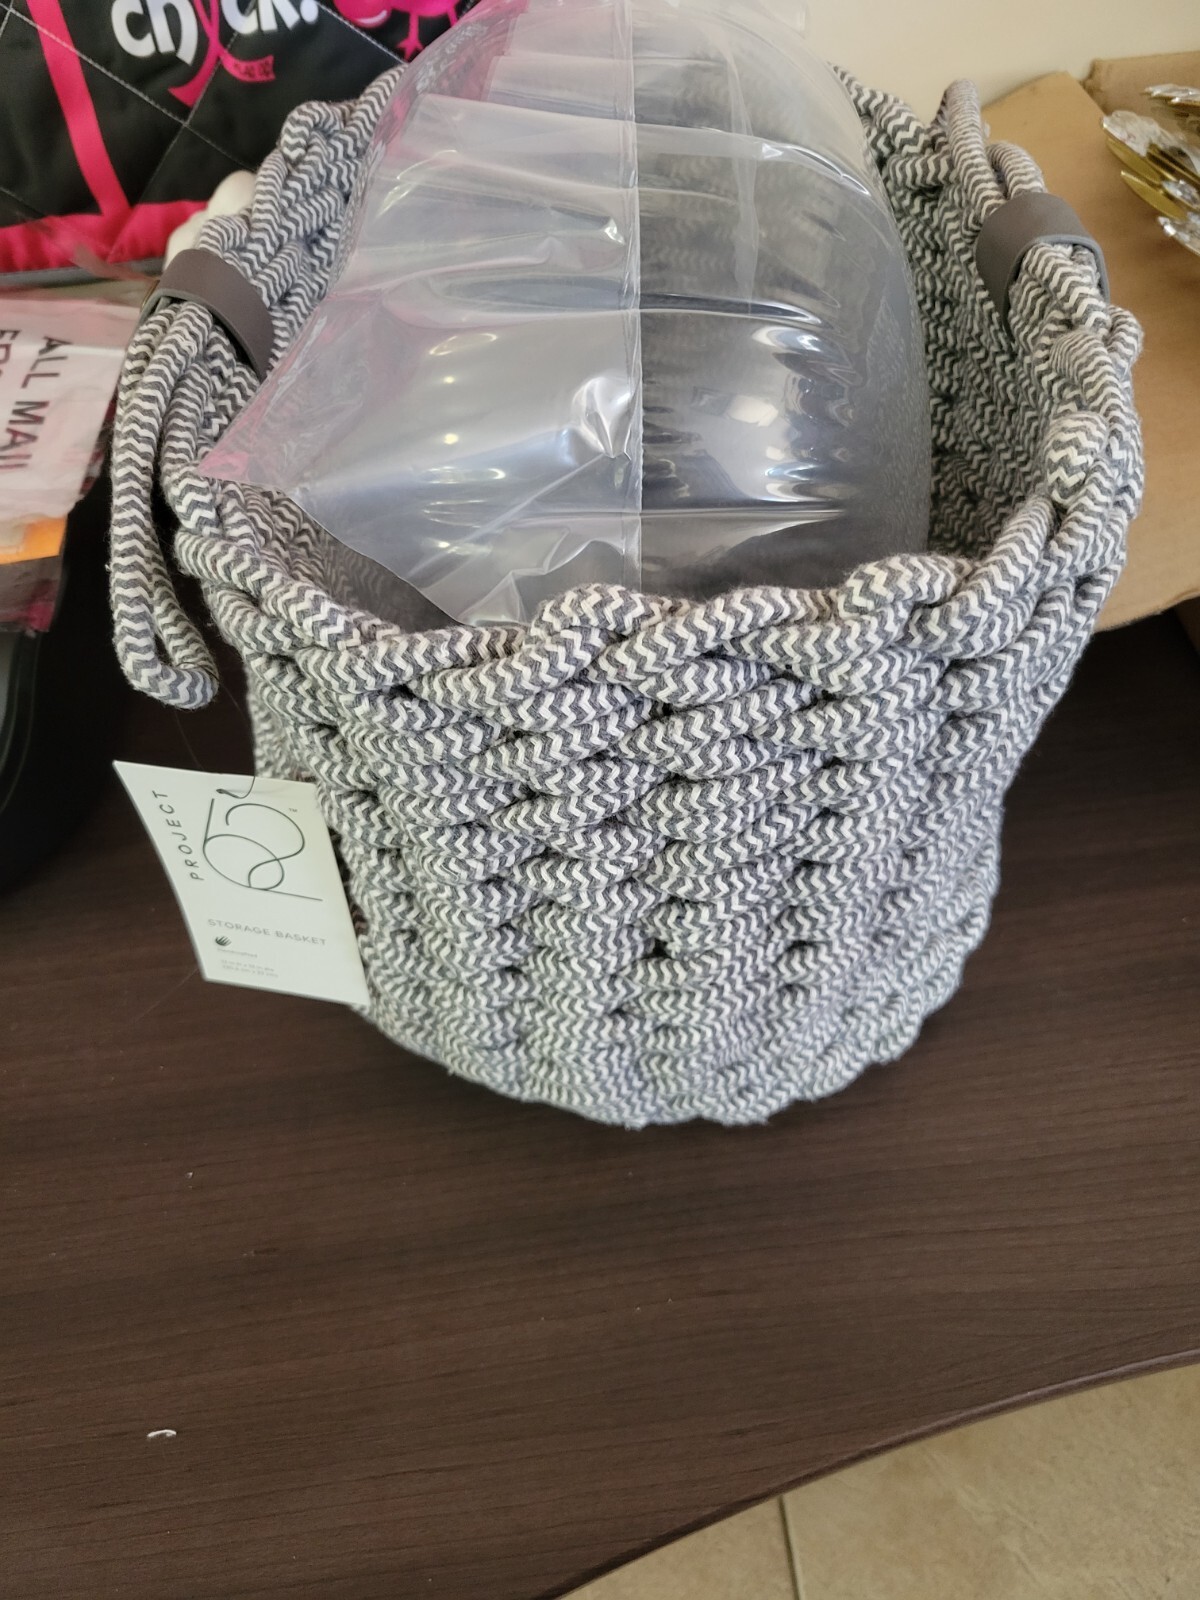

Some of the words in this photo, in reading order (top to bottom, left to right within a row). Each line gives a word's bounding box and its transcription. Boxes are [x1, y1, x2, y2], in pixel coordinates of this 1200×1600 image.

[21, 335, 72, 389] ALL
[152, 790, 204, 882] PROJECT
[207, 918, 271, 936] STORAGE
[275, 930, 327, 946] BASKET
